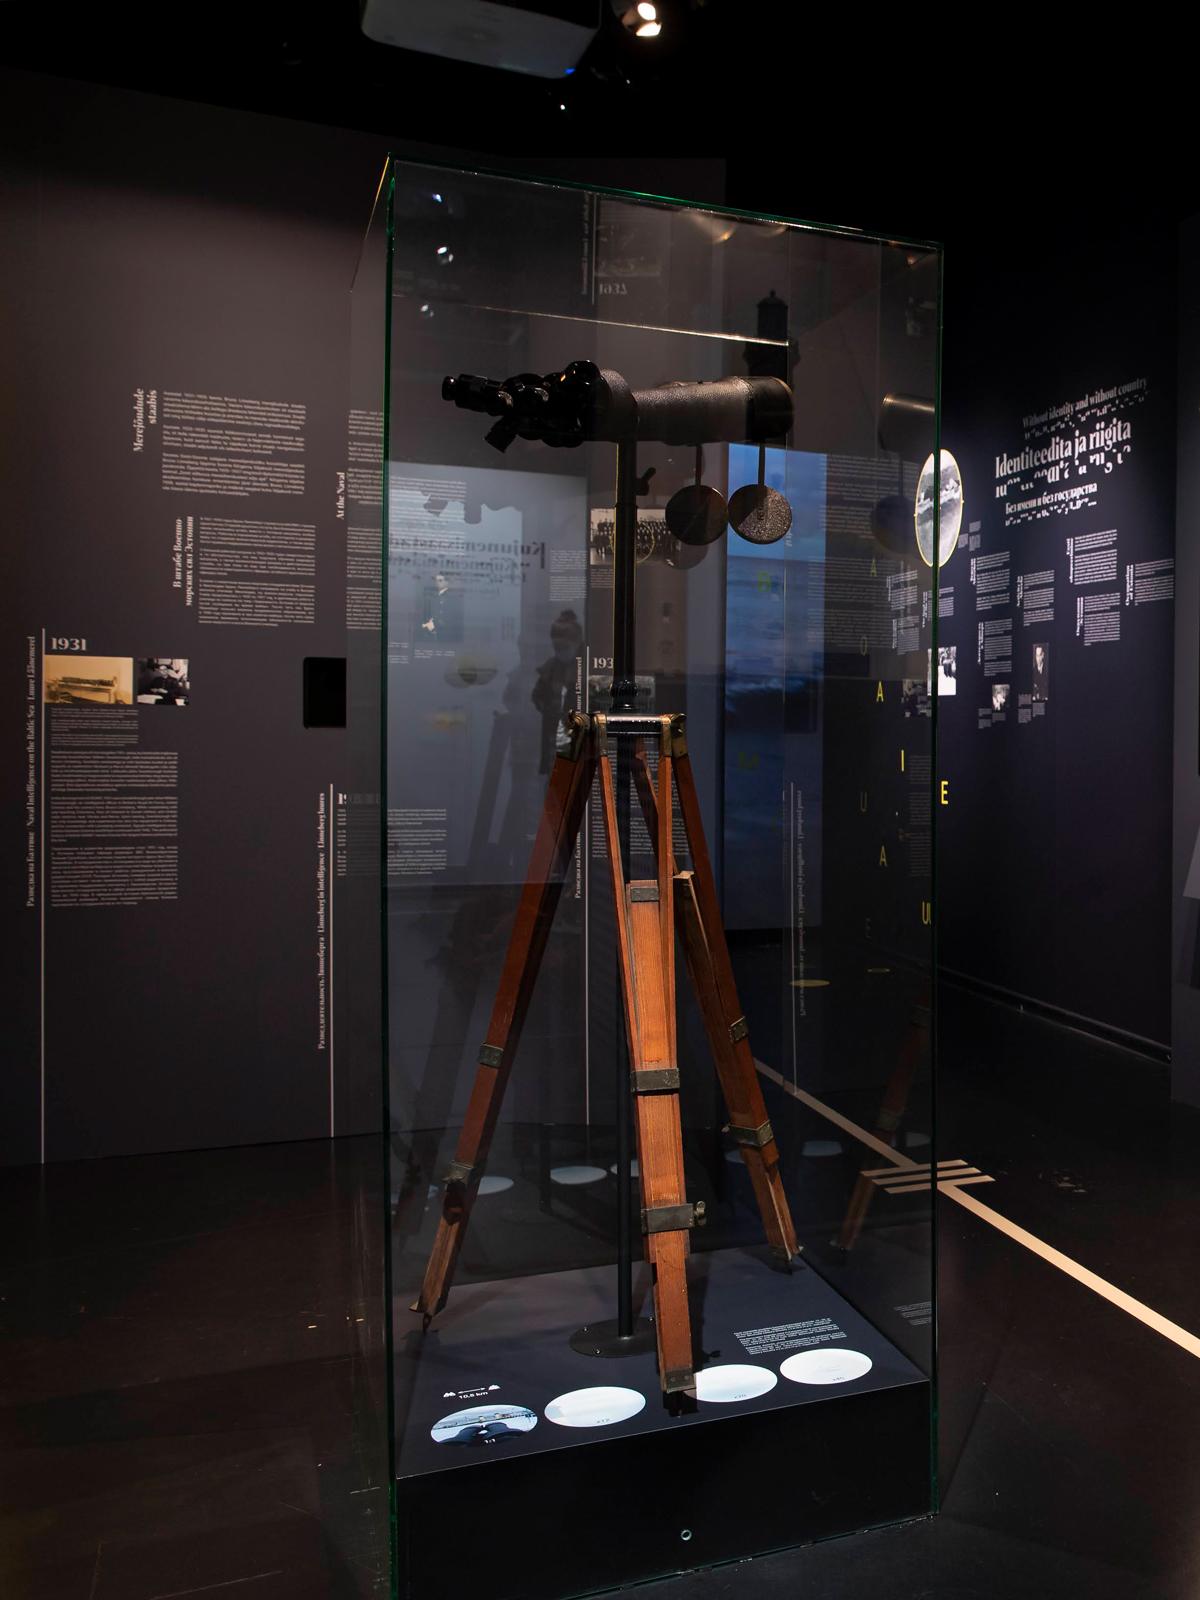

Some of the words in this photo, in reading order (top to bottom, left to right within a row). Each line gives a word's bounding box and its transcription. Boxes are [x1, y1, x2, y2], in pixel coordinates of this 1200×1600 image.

[147, 389, 158, 425] staabis
[1022, 414, 1050, 429] Without
[1050, 402, 1074, 422] identity
[1075, 394, 1089, 411] and
[1089, 386, 1117, 406] without
[1118, 377, 1148, 396] country
[133, 388, 145, 452] Merejõudude
[995, 435, 1073, 479] Identiteedita
[1074, 429, 1087, 460] ja
[1089, 417, 1132, 451] riigita
[336, 472, 345, 494] Naval
[336, 495, 345, 508] the
[50, 637, 87, 651] 1931
[592, 656, 615, 670] 193
[876, 680, 885, 702] A
[940, 780, 950, 805] E
[879, 845, 888, 867] A
